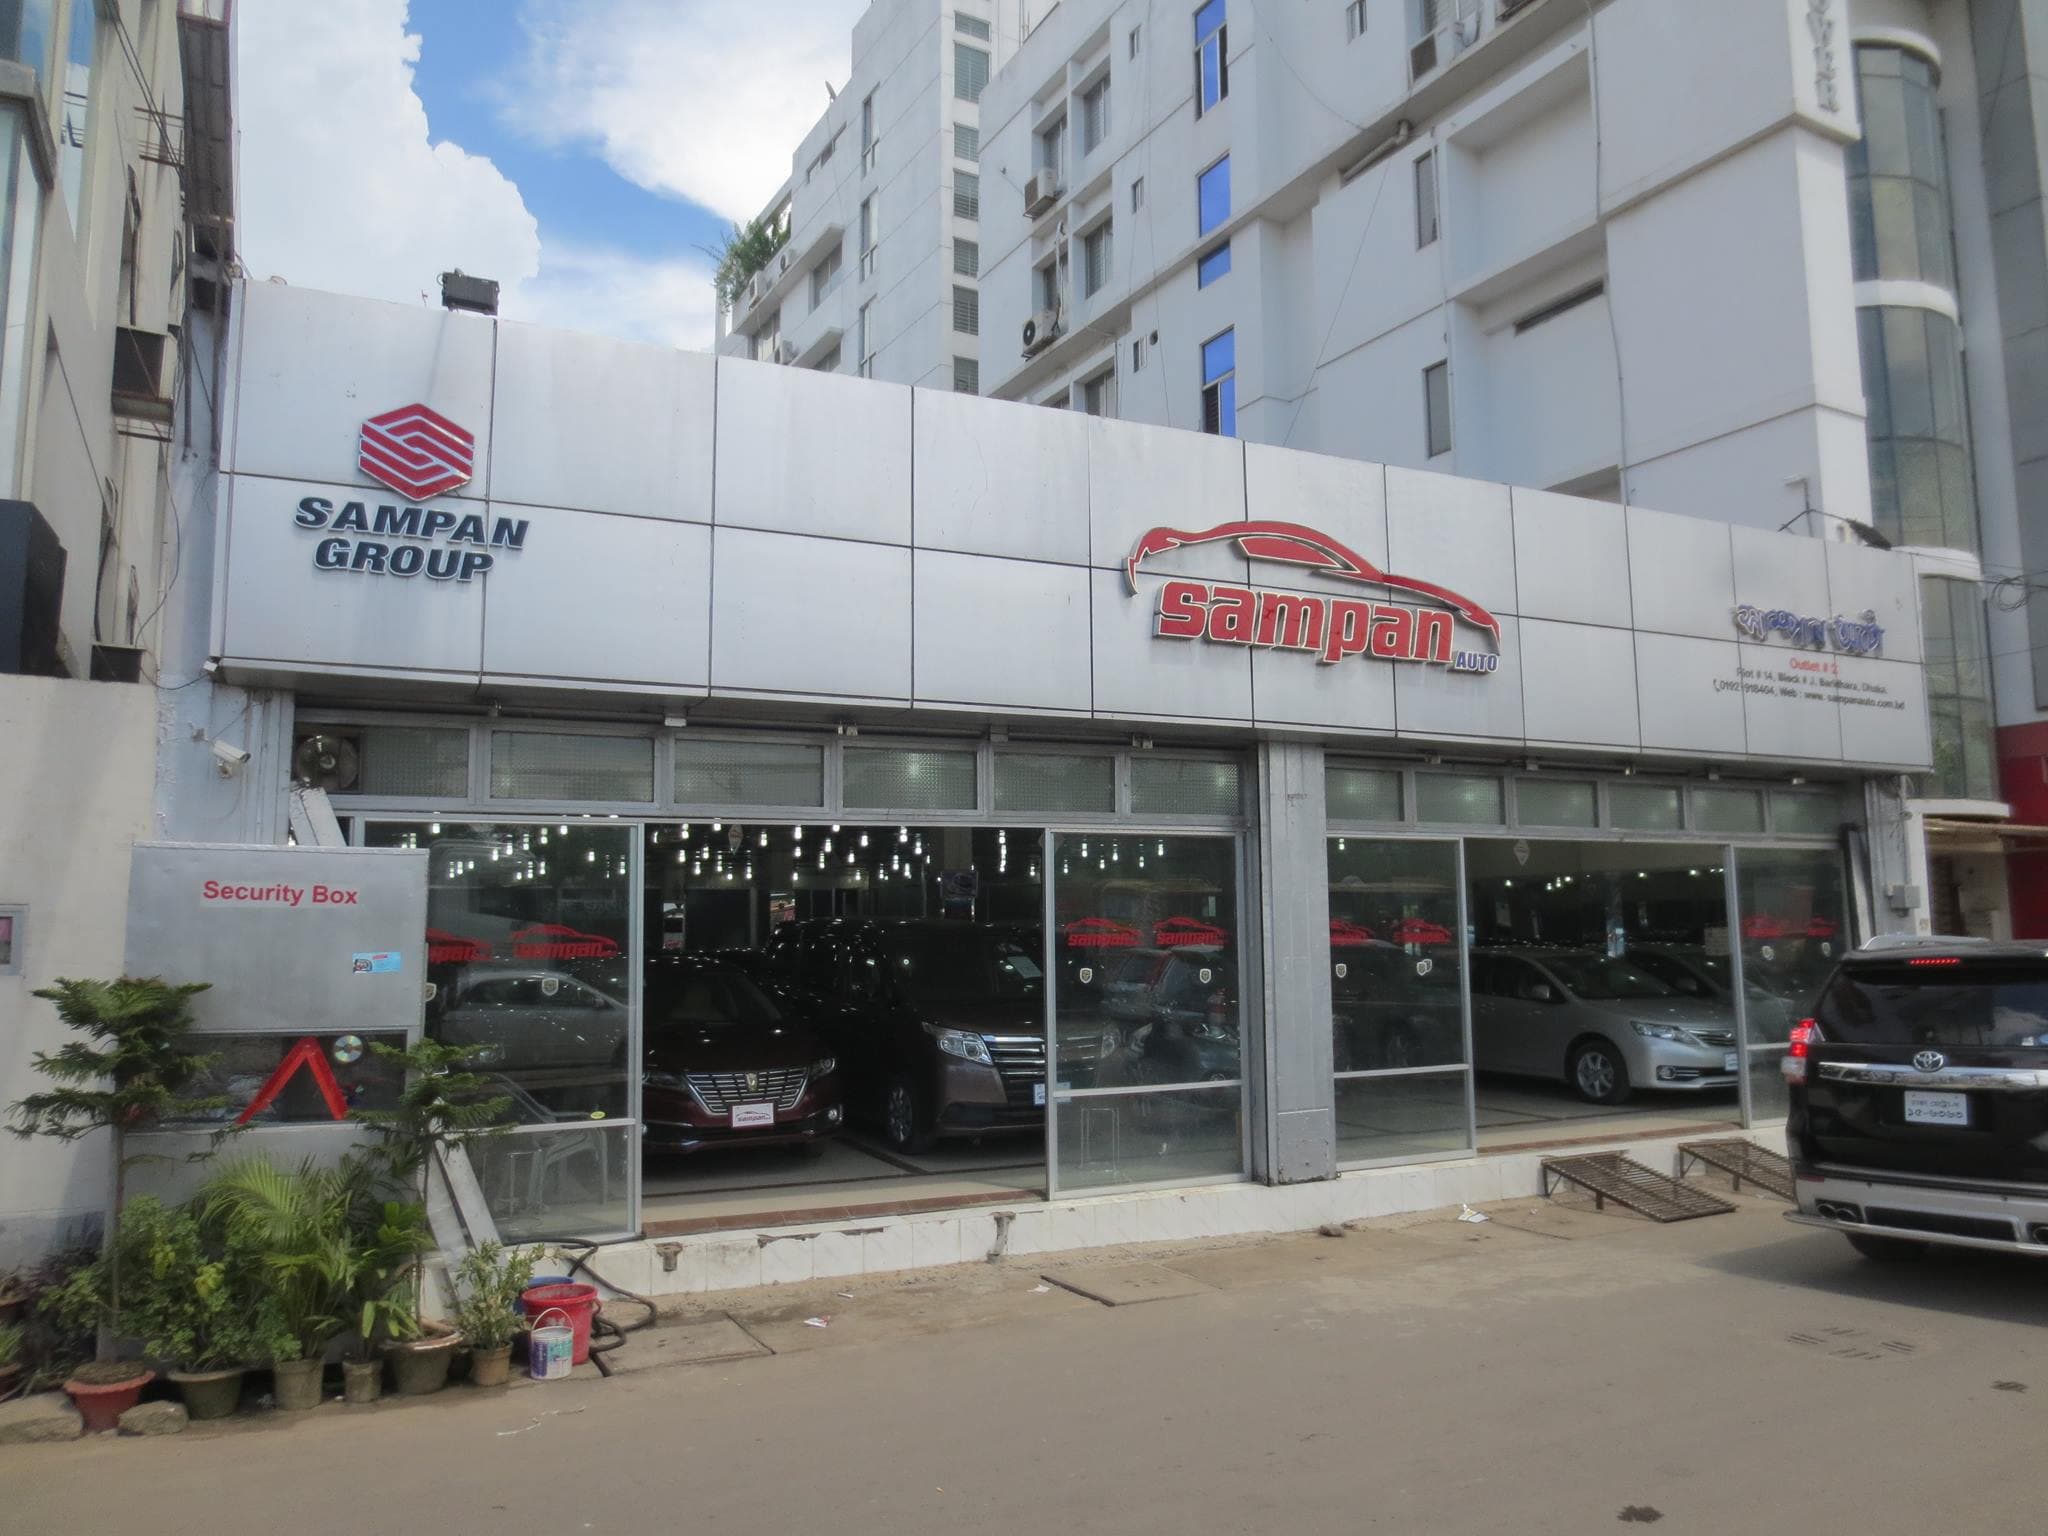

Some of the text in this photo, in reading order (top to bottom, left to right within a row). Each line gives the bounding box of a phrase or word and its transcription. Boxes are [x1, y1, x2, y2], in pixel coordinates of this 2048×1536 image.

[294, 497, 530, 550] SAMPAN
[314, 537, 495, 582] GROUP
[1154, 580, 1455, 664] sampan
[1454, 651, 1500, 673] AUTO
[1789, 656, 1820, 673] Outlet
[203, 880, 358, 907] Security Box
